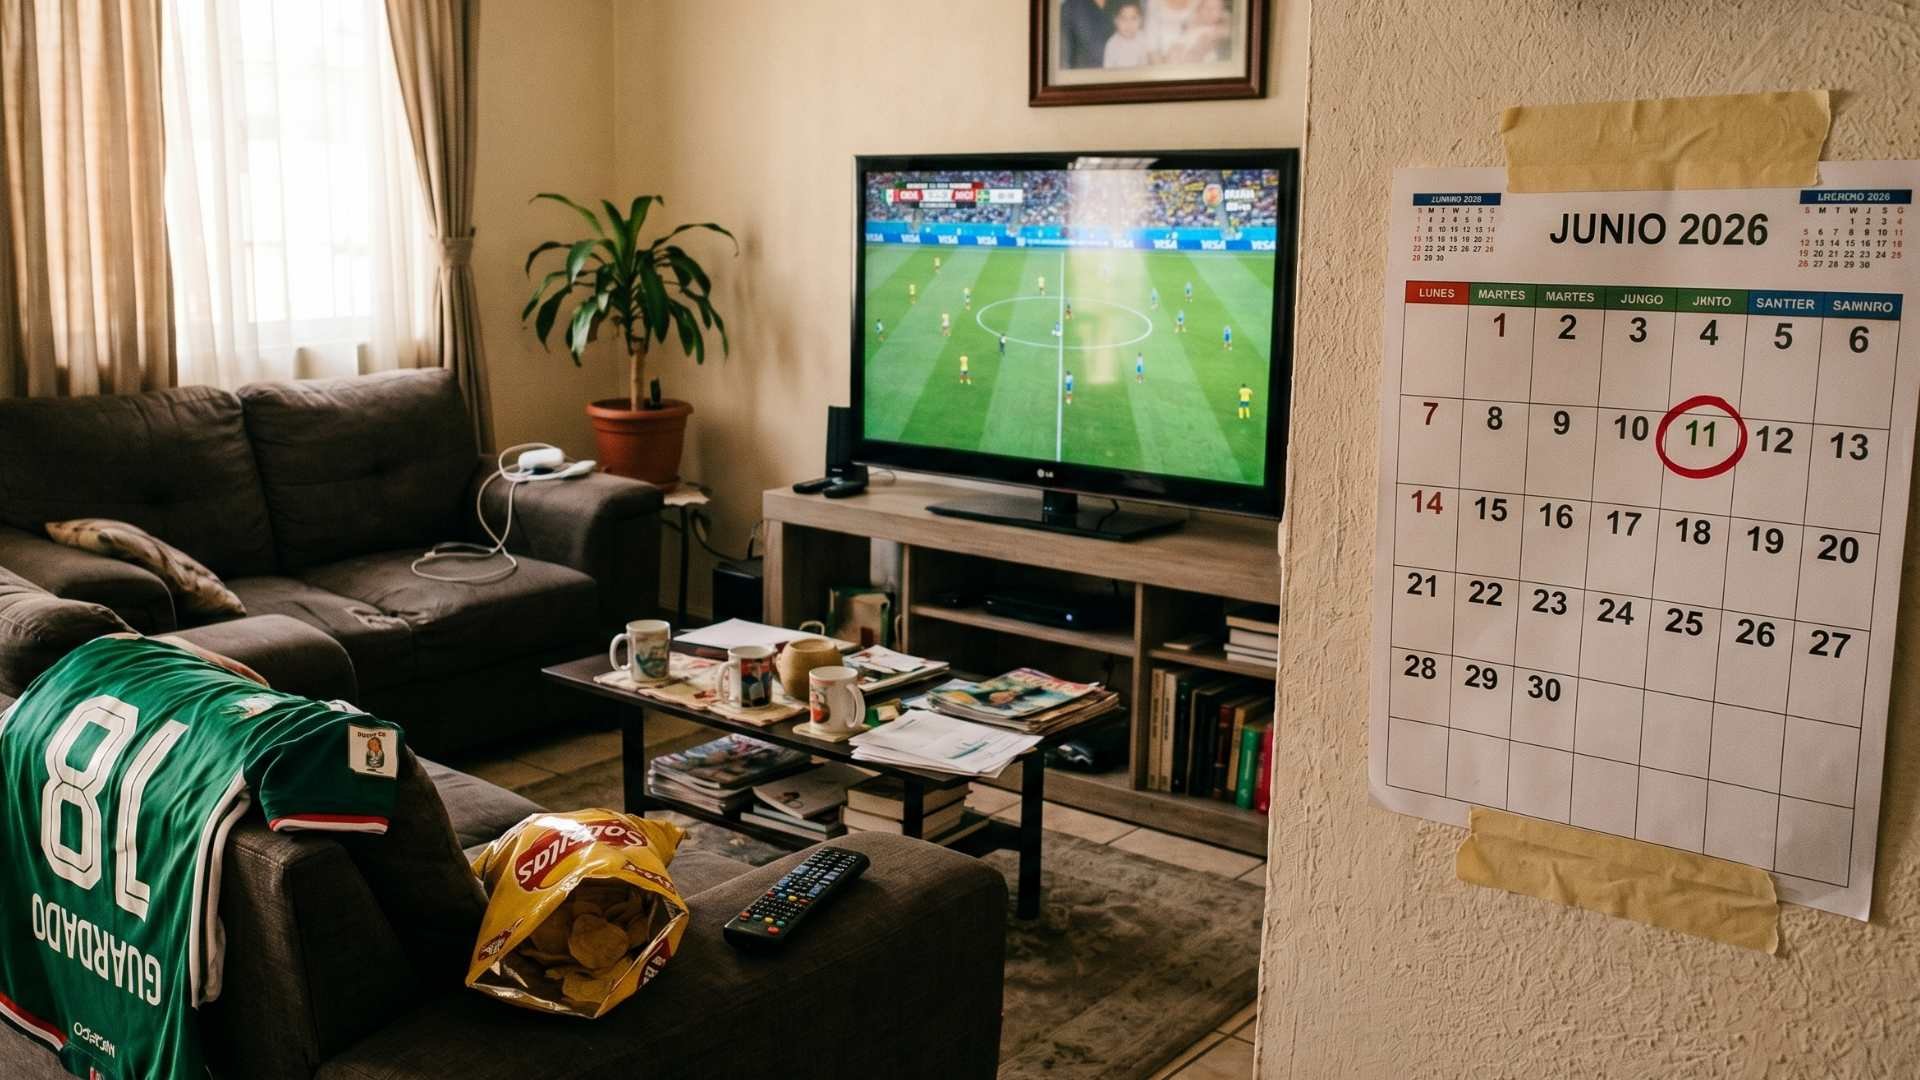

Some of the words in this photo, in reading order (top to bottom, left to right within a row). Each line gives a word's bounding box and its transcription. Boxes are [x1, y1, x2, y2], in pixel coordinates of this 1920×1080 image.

[1867, 193, 1891, 201] 2026
[1549, 212, 1667, 245] JUNIO
[1678, 212, 1769, 246] 2026
[1830, 239, 1840, 248] 14
[1845, 239, 1856, 248] 15
[1877, 239, 1887, 248] 17
[1877, 228, 1888, 237] 10
[1894, 228, 1903, 237] 11
[1813, 260, 1824, 269] 27
[1843, 250, 1855, 259] 22
[1419, 288, 1455, 298] LUNES
[1546, 291, 1595, 302] MARTES
[1620, 293, 1664, 305] JUNGO
[1493, 312, 1506, 338] 1
[1557, 313, 1577, 340] 2
[1628, 316, 1647, 343] 3
[1699, 319, 1719, 346] 4
[1773, 322, 1793, 350] 5
[1849, 325, 1870, 354] 6
[1423, 401, 1439, 426] 7
[1486, 405, 1503, 431] 8
[1553, 410, 1571, 436] 9
[1614, 414, 1649, 442] 10
[1685, 419, 1716, 448] 11
[1756, 425, 1794, 455] 12
[1830, 431, 1869, 461] 13
[1411, 489, 1444, 515] 14
[1474, 496, 1508, 522] 15
[1539, 502, 1574, 530] 16
[1606, 509, 1643, 537] 17
[1675, 517, 1711, 546] 18
[1747, 525, 1784, 555] 19
[1816, 533, 1860, 564] 20
[1406, 572, 1437, 598] 21
[1468, 579, 1503, 607] 22
[1531, 588, 1567, 616] 23
[1596, 597, 1635, 626] 24
[1664, 607, 1704, 637] 25
[1735, 618, 1776, 648] 26
[1808, 629, 1852, 659] 27
[1403, 654, 1437, 680] 28
[1464, 664, 1498, 690] 29
[1527, 674, 1562, 703] 30
[41, 694, 189, 922] 18
[31, 893, 162, 1006] GUARDADO
